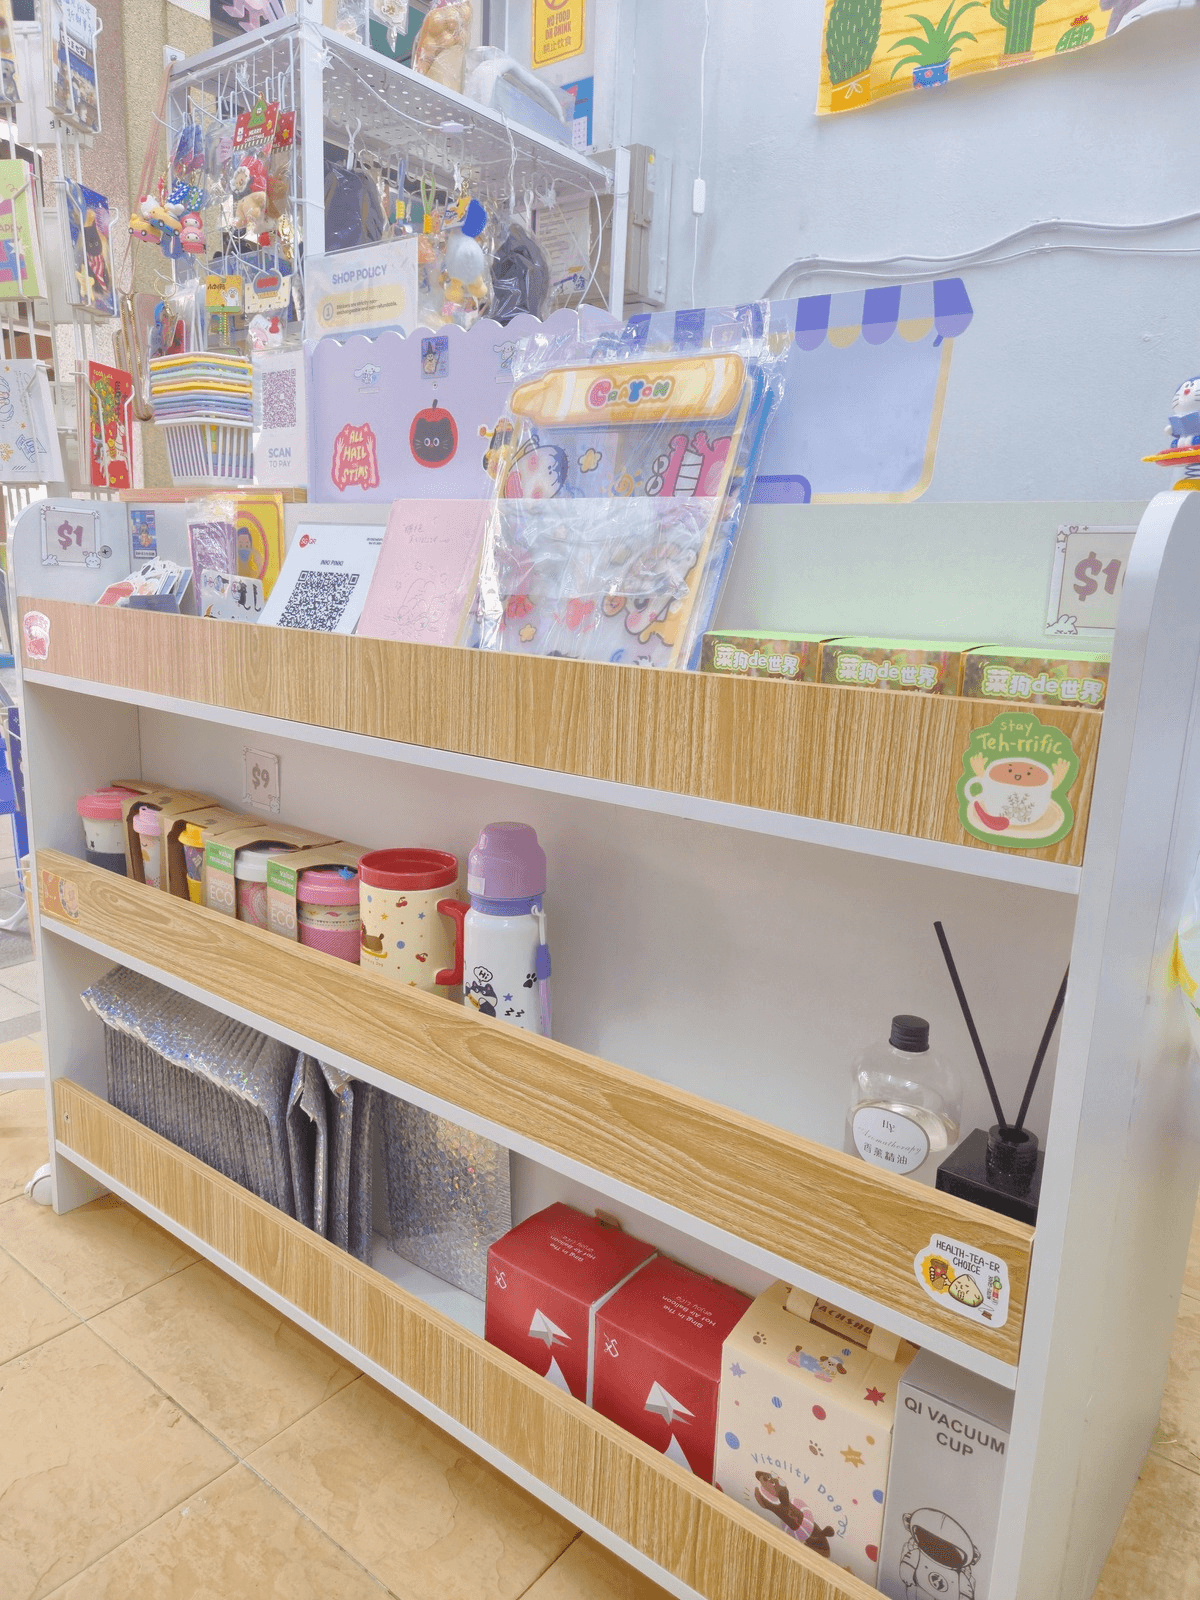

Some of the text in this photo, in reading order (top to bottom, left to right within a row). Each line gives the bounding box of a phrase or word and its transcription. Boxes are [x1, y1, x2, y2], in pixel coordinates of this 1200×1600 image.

[546, 9, 571, 27] NO FOOD
[0, 223, 22, 233] APPY
[332, 264, 387, 284] SHOP POLICY
[349, 430, 363, 443] ALL
[268, 447, 291, 459] SCAN
[278, 460, 291, 468] PAY
[343, 445, 366, 461] HAIL
[57, 520, 84, 550] $1
[1073, 551, 1126, 601] $1
[715, 644, 799, 675] 菜狗de世界
[838, 656, 937, 688] 菜狗de世界
[985, 667, 1104, 703] 菜狗de世界
[976, 732, 1062, 755] Teh-rrific
[252, 763, 269, 790] $9
[210, 886, 234, 906] ECO
[271, 910, 295, 930] ECO
[936, 1240, 1000, 1273] HEALTH-TEA-ER
[952, 1257, 981, 1275] CHOICE
[904, 1396, 1006, 1455] QI VACUUM
[936, 1432, 974, 1456] CUP
[750, 1452, 843, 1513] Vitality Dog
